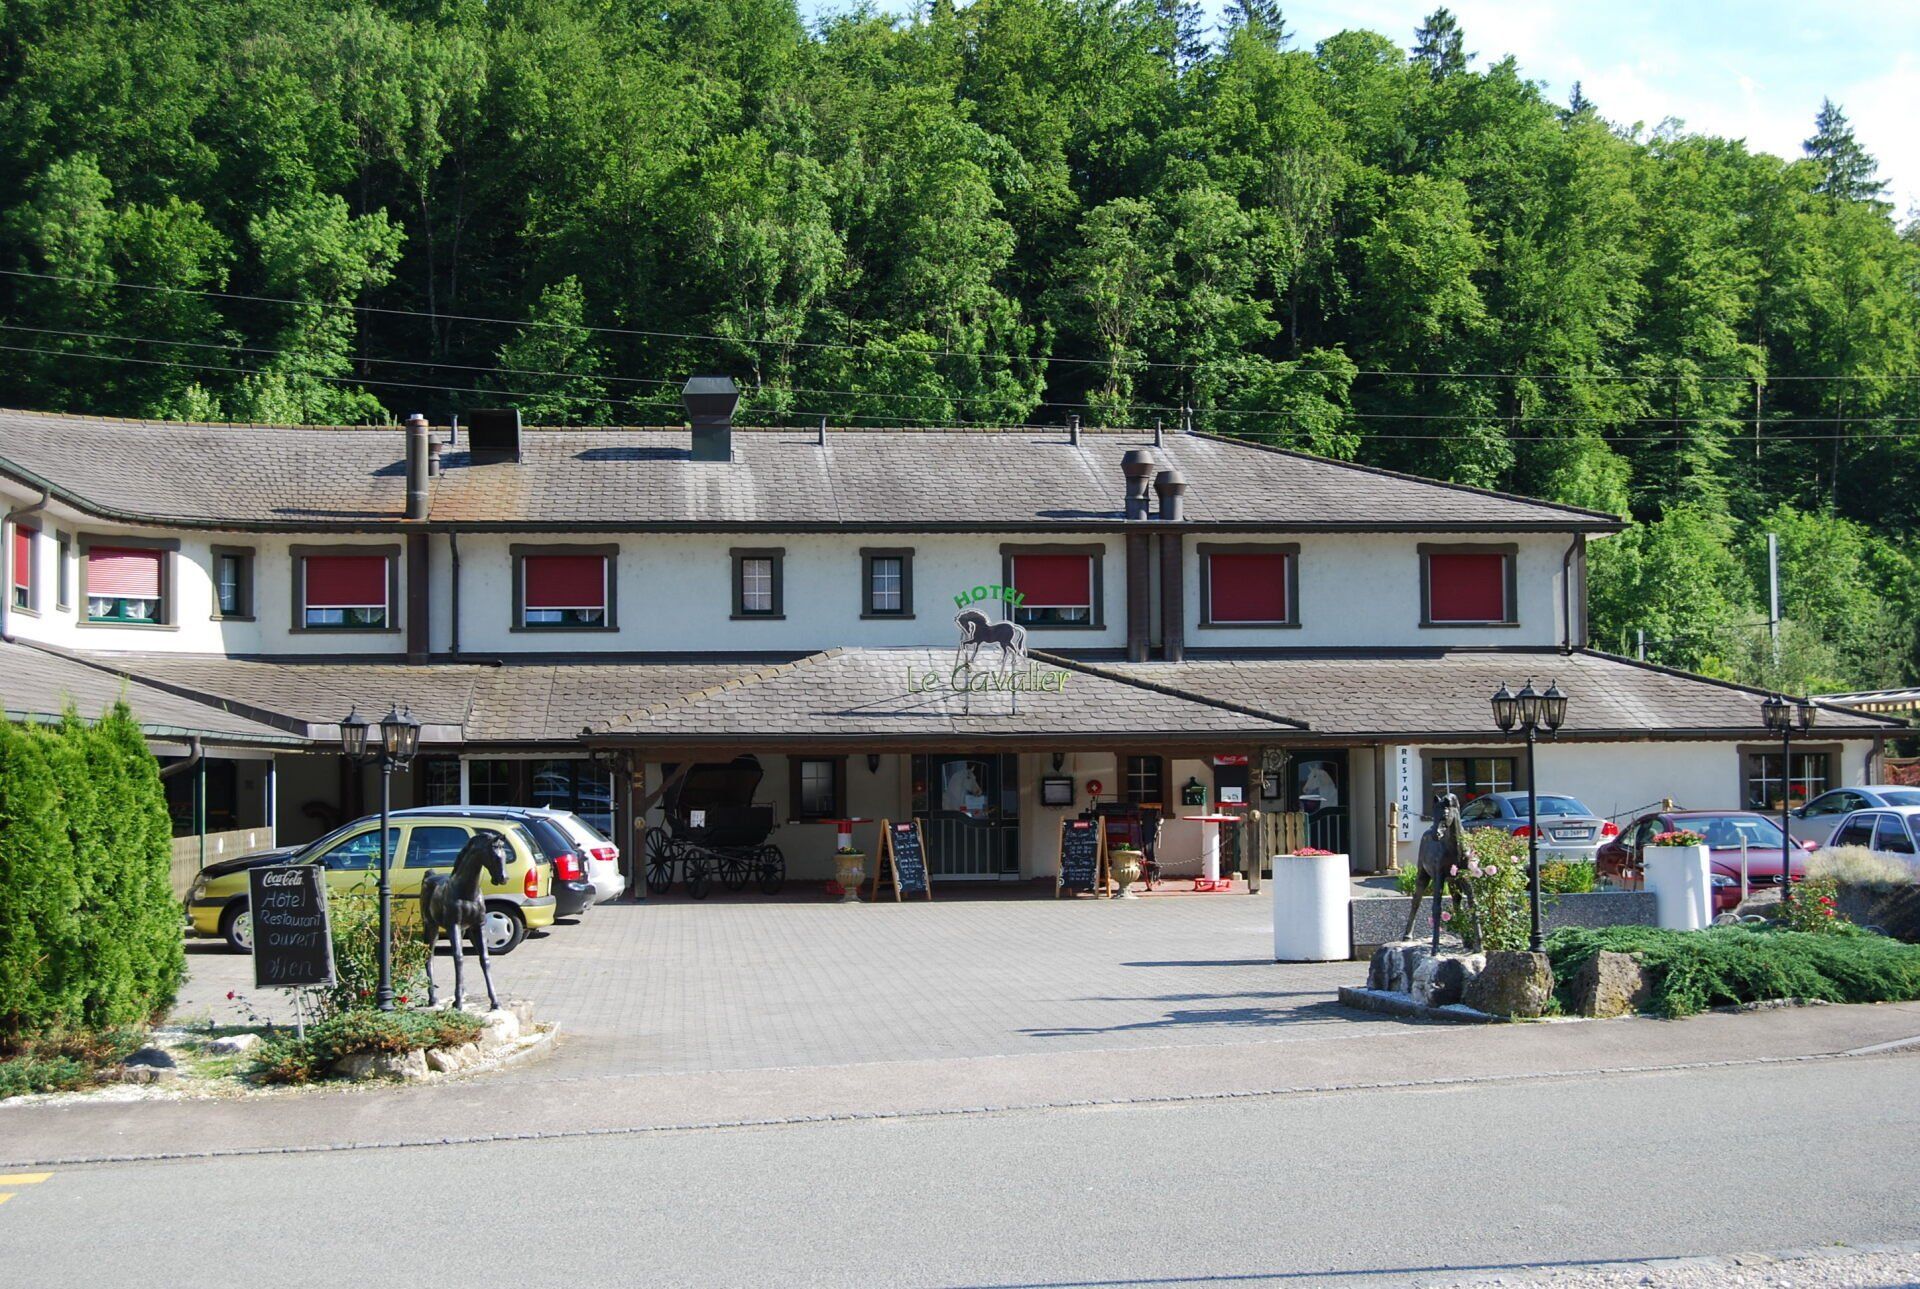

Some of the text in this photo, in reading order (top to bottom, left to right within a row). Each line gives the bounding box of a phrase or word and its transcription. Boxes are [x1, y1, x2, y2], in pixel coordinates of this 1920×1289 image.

[954, 584, 1025, 609] HOTEL
[907, 661, 1072, 694] Le Cavalier
[1401, 748, 1409, 839] RESTAURANT
[262, 869, 304, 888] Coca-Cola
[260, 888, 306, 908] Hôtel
[260, 909, 322, 928] Restaurant
